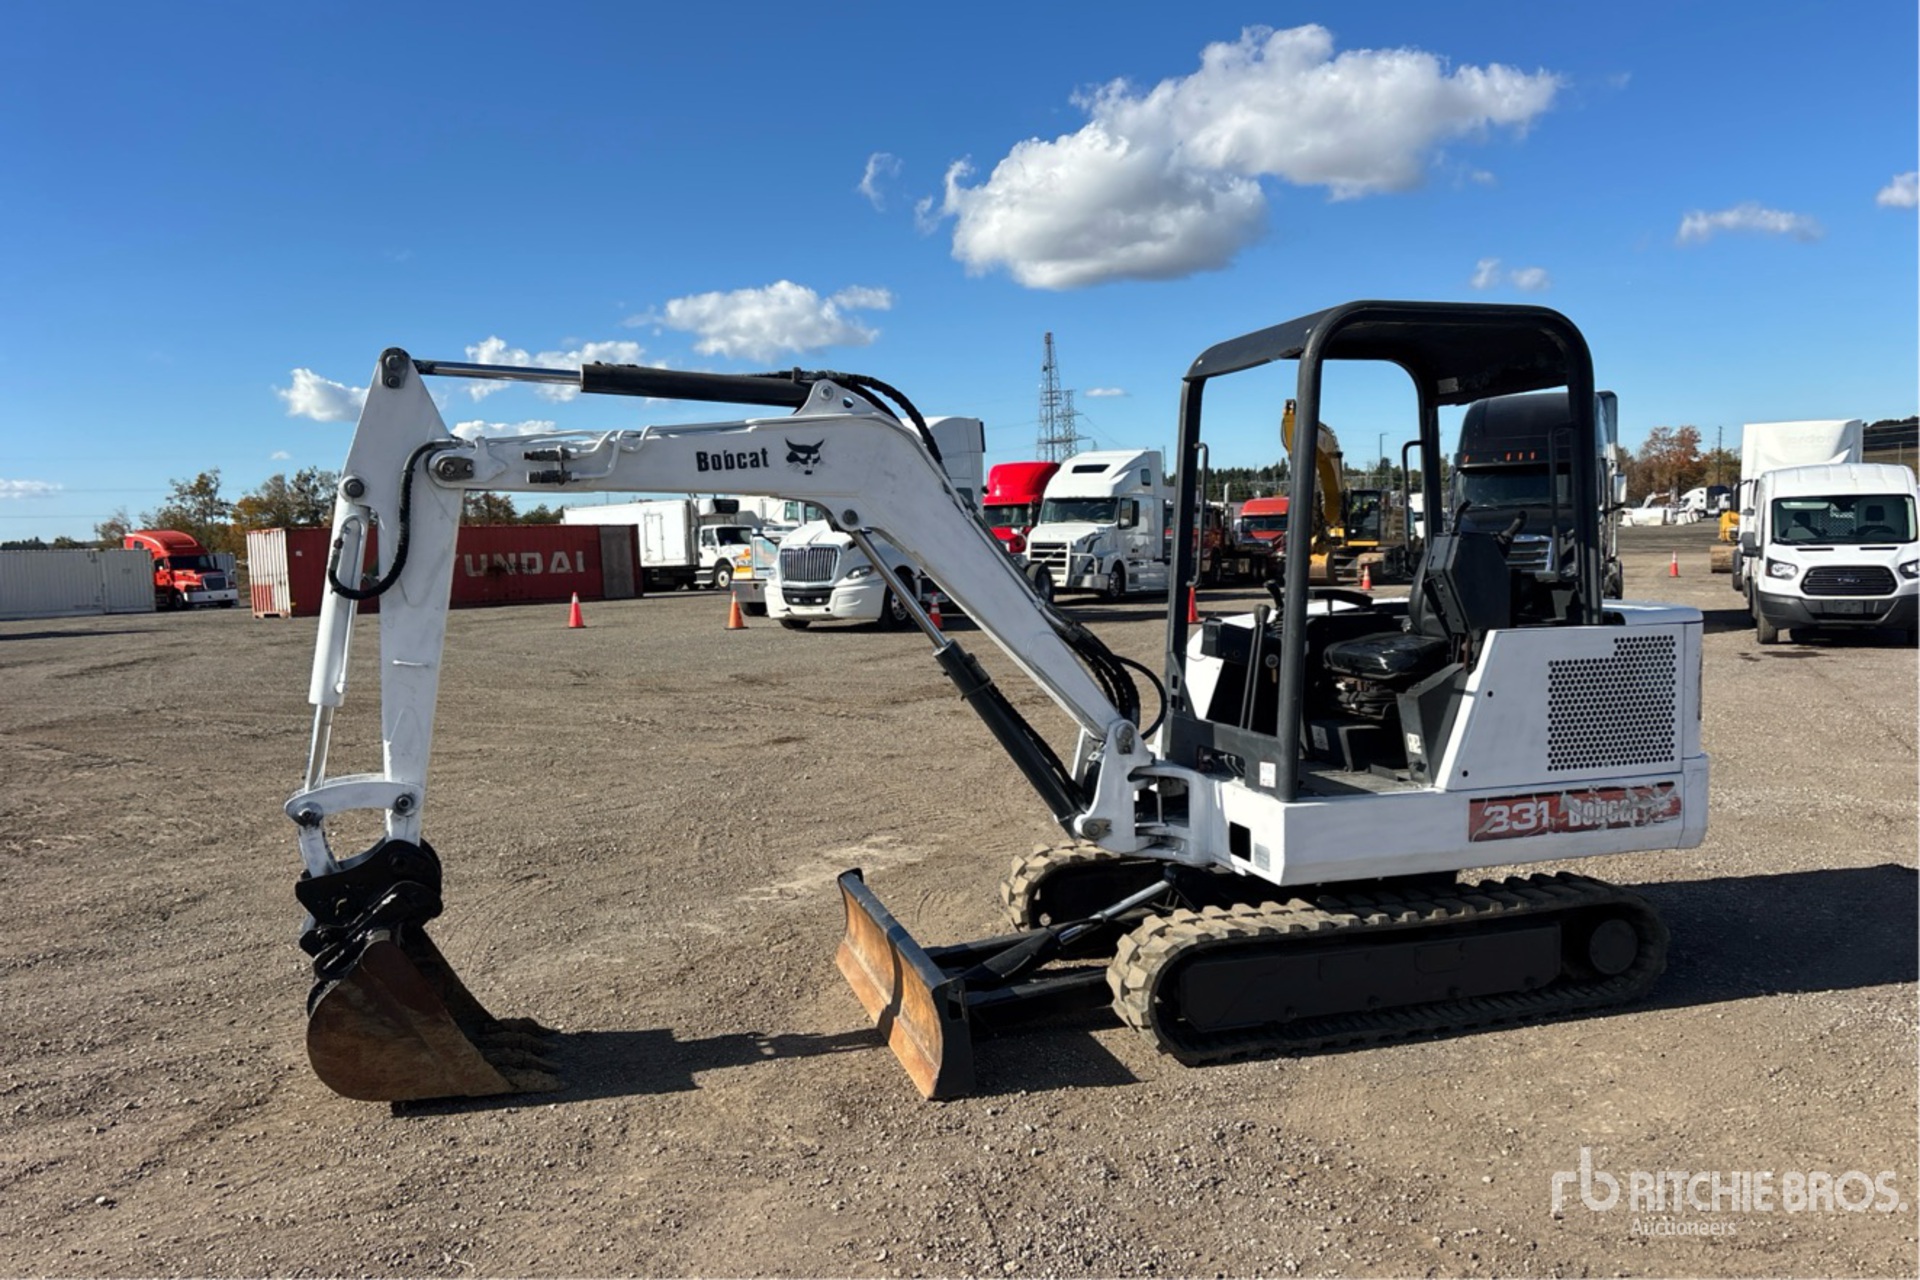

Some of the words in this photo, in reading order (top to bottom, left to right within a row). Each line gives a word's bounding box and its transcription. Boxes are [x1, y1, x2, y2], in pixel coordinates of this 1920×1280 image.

[696, 447, 769, 472] Bobcat
[456, 551, 585, 577] UNDAI
[1484, 801, 1549, 833] 331
